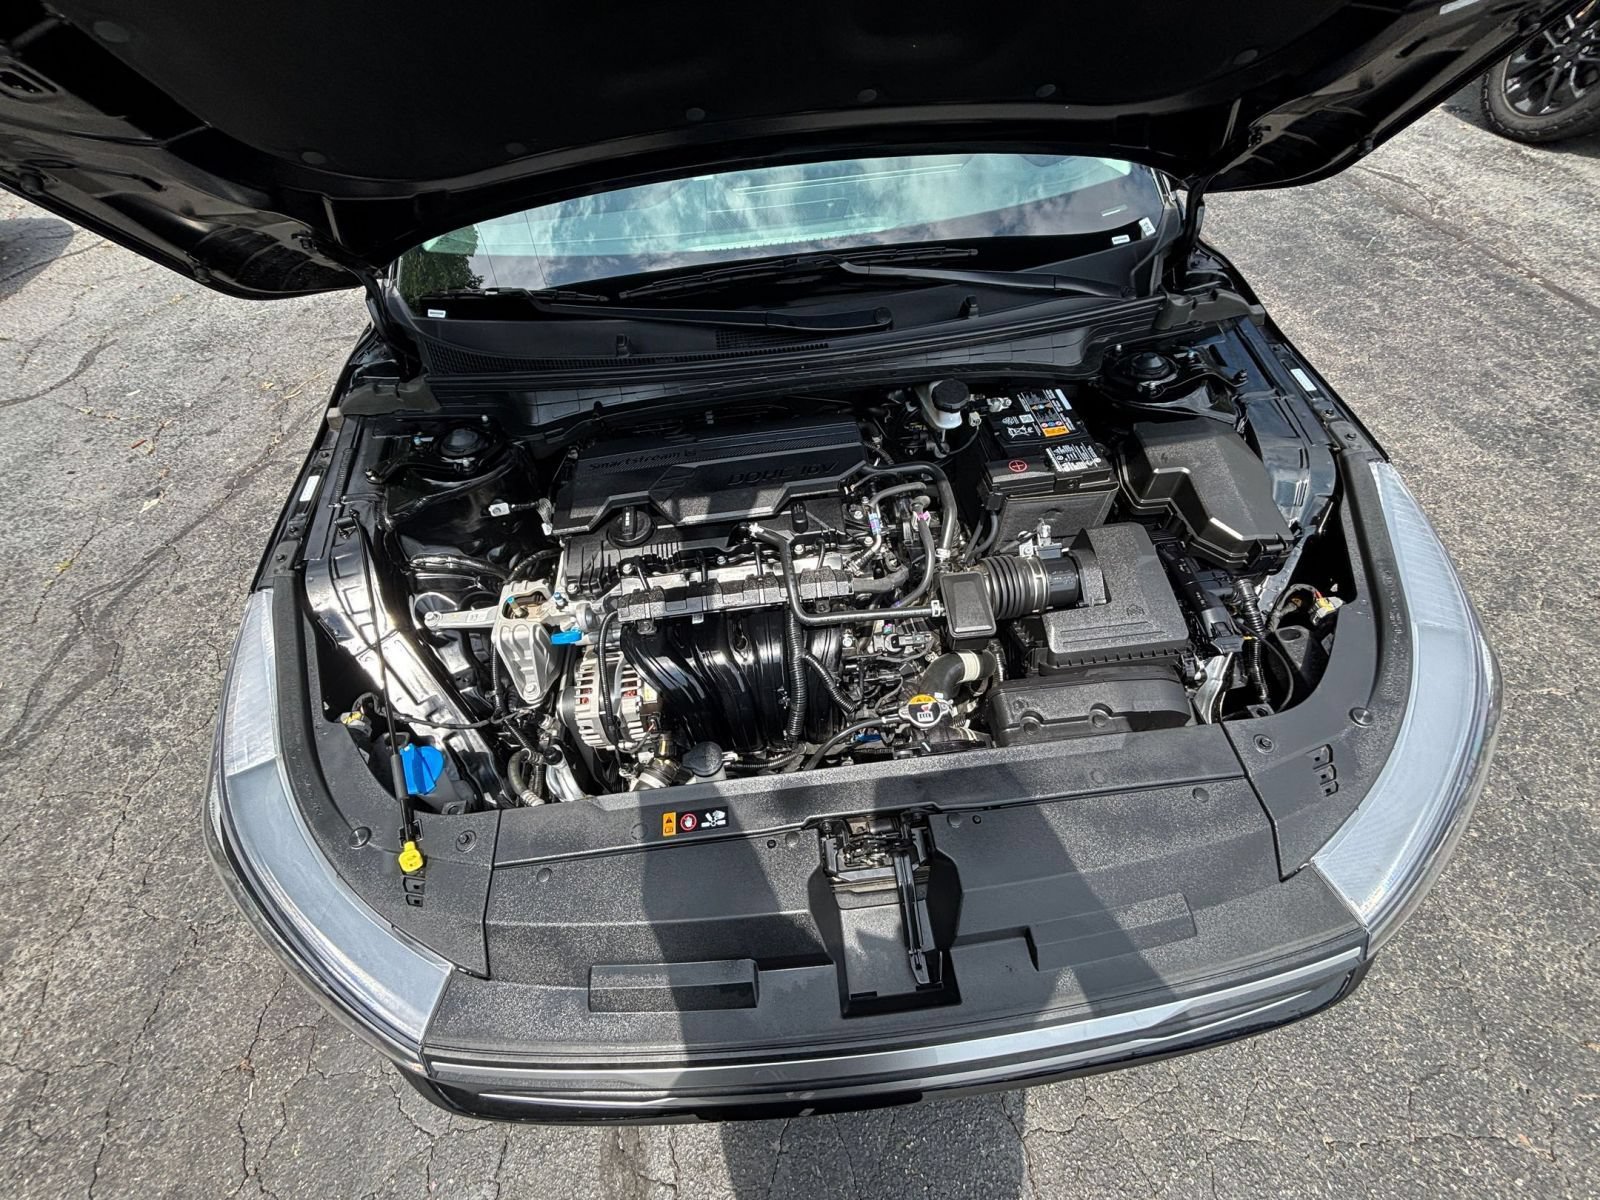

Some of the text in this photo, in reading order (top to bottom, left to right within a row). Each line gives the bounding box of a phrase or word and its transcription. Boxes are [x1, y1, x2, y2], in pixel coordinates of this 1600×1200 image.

[589, 451, 681, 470] Smartstream
[727, 461, 840, 486] DOHC 16V
